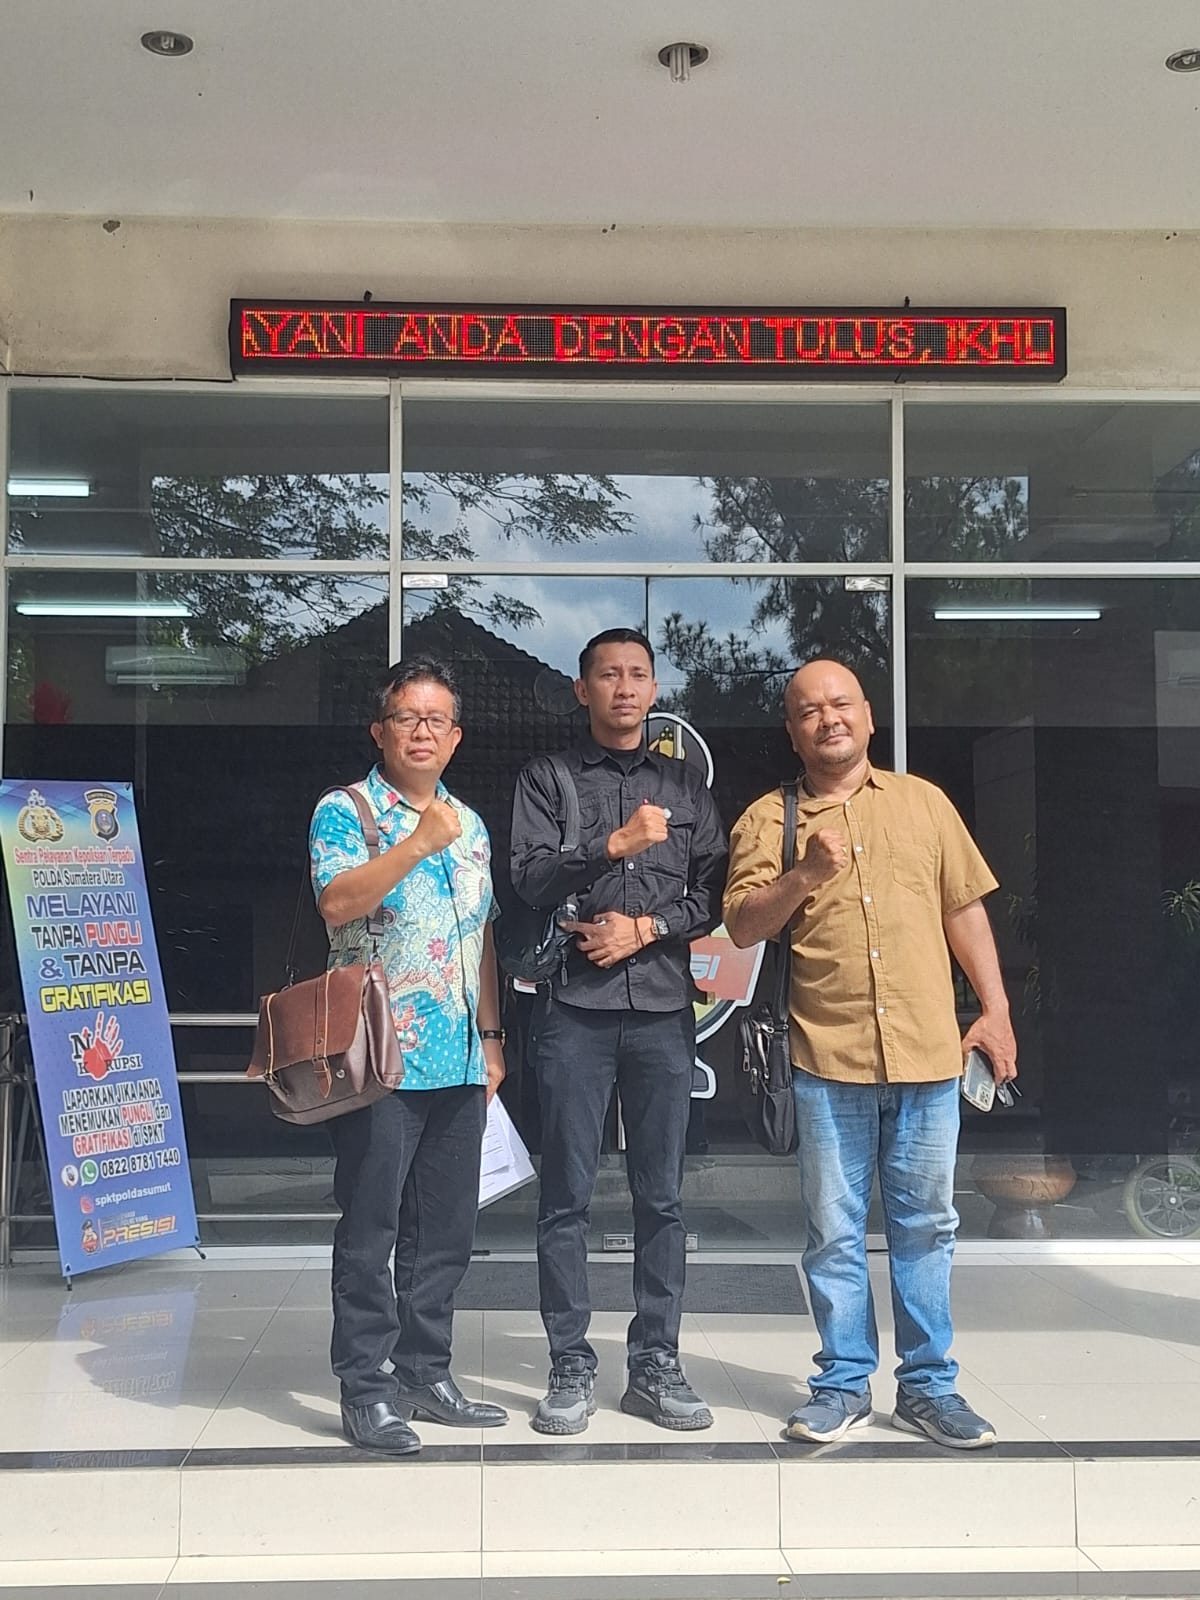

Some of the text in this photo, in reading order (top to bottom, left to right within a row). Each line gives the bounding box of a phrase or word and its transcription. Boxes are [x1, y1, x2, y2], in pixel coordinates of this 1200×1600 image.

[394, 314, 527, 356] ANDA
[555, 315, 750, 359] DENGAN
[764, 318, 932, 363] TULUS,
[33, 869, 124, 886] POLDA Sumatera Utara
[26, 892, 137, 919] MELAYANI
[31, 921, 142, 949] TANPA PUNGLI
[40, 950, 146, 980] & TANPA
[40, 978, 152, 1013] GRATIFIKASI
[63, 1079, 161, 1111] LAPORKAN JIKA ANDA
[60, 1103, 171, 1135] MENEMUKAN PUNGLI dan
[74, 1123, 164, 1156] GRATIFIKASI di SPKT
[101, 1148, 180, 1178] 0822 8781 7440
[95, 1182, 172, 1208] spktpoldasumut
[103, 1215, 176, 1245] PRESISI
